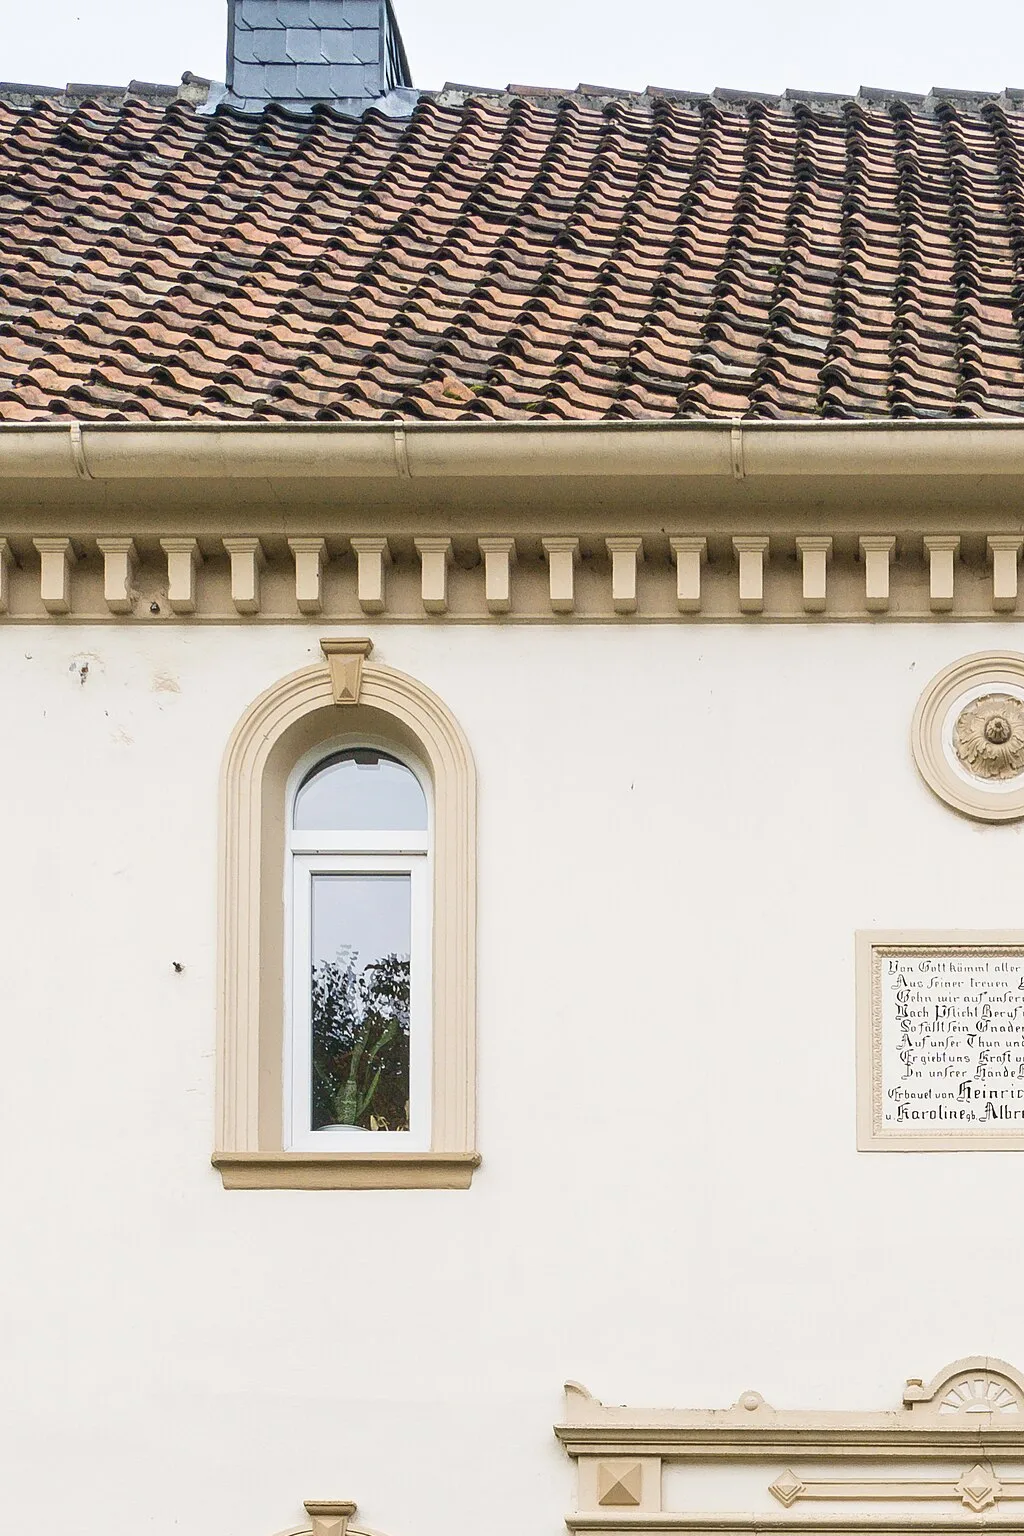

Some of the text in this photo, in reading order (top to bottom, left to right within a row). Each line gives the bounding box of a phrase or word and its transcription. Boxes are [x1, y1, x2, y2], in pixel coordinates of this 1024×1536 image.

[888, 961, 913, 975] Von
[918, 960, 946, 972] Gott
[995, 962, 1021, 972] aller
[891, 974, 923, 990] Aus
[970, 977, 1008, 987] treuen
[897, 989, 932, 1003] Gehn
[938, 992, 960, 1002] wir
[963, 992, 987, 1004] auf
[935, 1005, 978, 1021] Pflicht
[981, 1004, 1022, 1019] Beruf
[900, 1019, 917, 1033] So
[918, 1020, 945, 1034] fällt
[896, 1034, 930, 1050] Auf
[967, 1034, 1000, 1048] Thun
[921, 1051, 946, 1065] giebt
[948, 1054, 970, 1063] uns
[979, 1050, 1011, 1064] Kraft
[974, 1063, 1016, 1081] Hände
[897, 1102, 965, 1122] Karoline
